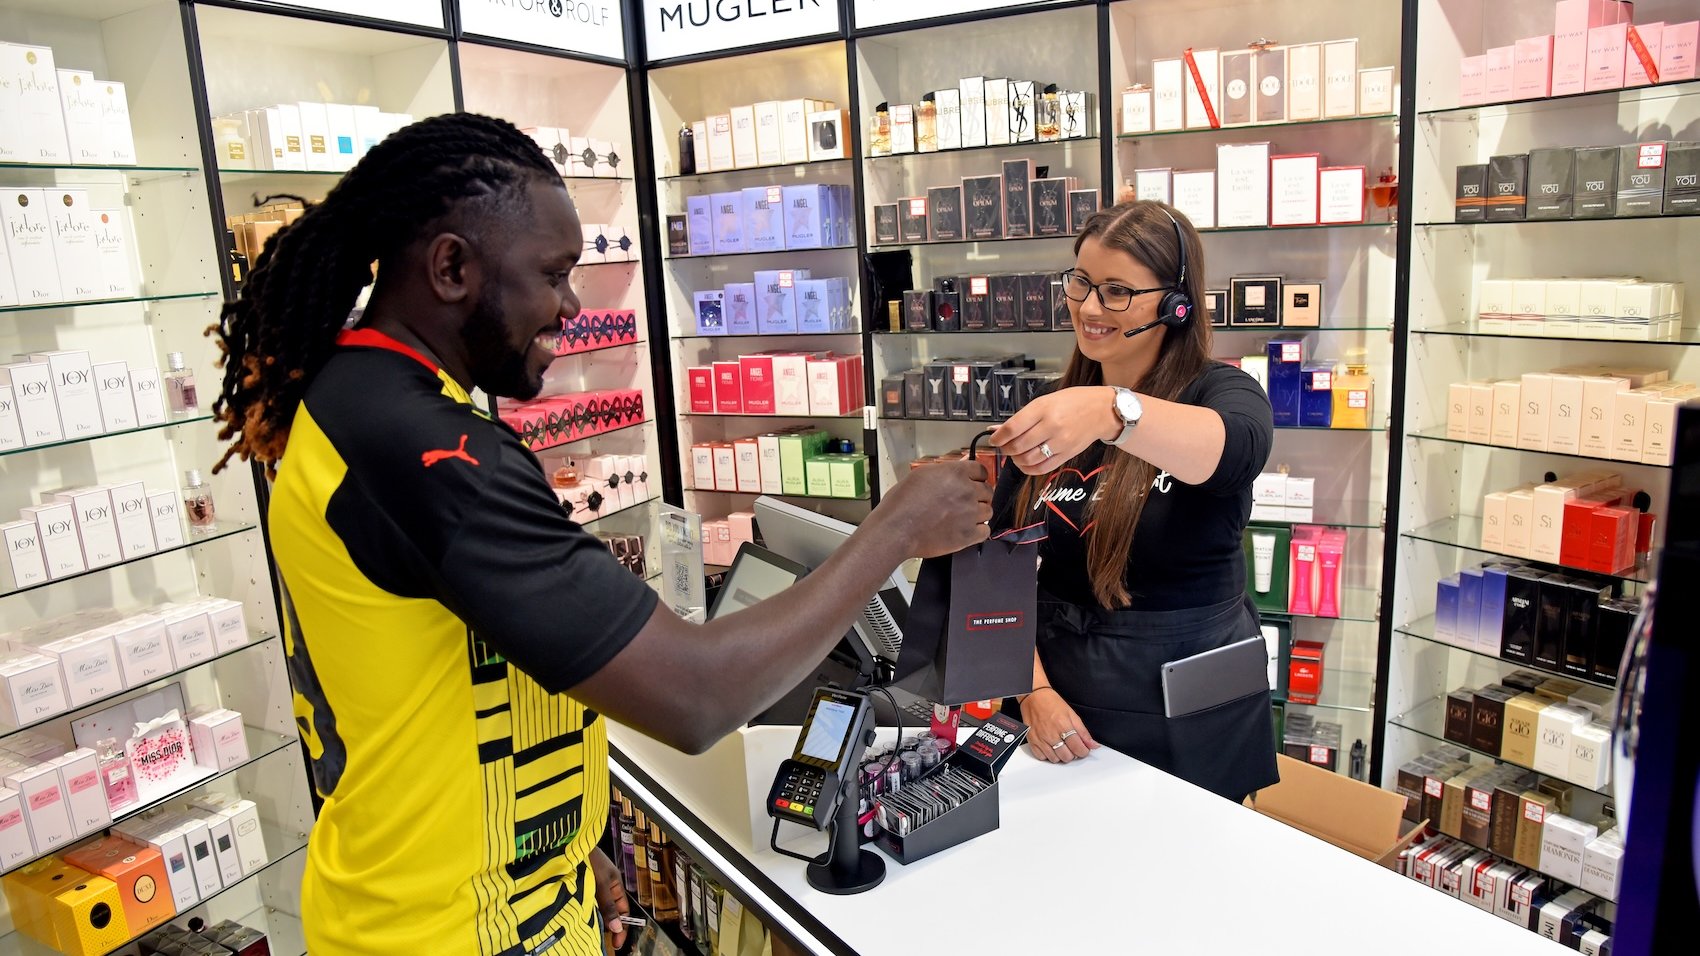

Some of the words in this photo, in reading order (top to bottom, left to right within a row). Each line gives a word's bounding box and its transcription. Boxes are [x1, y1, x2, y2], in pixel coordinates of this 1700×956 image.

[566, 0, 608, 27] ROLF
[936, 106, 960, 116] LIBRE
[1499, 184, 1515, 192] YOU
[1586, 182, 1604, 192] YOU
[1631, 176, 1650, 184] YOU
[1676, 177, 1696, 186] YOU
[1463, 186, 1479, 194] YOU
[1541, 185, 1559, 194] YOU
[59, 369, 90, 387] JOY
[101, 376, 126, 392] JOY
[19, 380, 48, 398] JOY
[82, 506, 108, 522] JOY
[118, 498, 144, 514] JOY
[155, 504, 175, 518] JOY
[45, 520, 72, 537] JOY
[13, 536, 36, 551] JOY
[975, 729, 1001, 746] DIFFUSER
[982, 722, 1009, 739] PERFUME
[140, 749, 161, 766] MISS
[163, 741, 182, 757] DIOR
[1543, 845, 1580, 865] DIAMONDS
[1584, 866, 1614, 882] DIAMONDS
